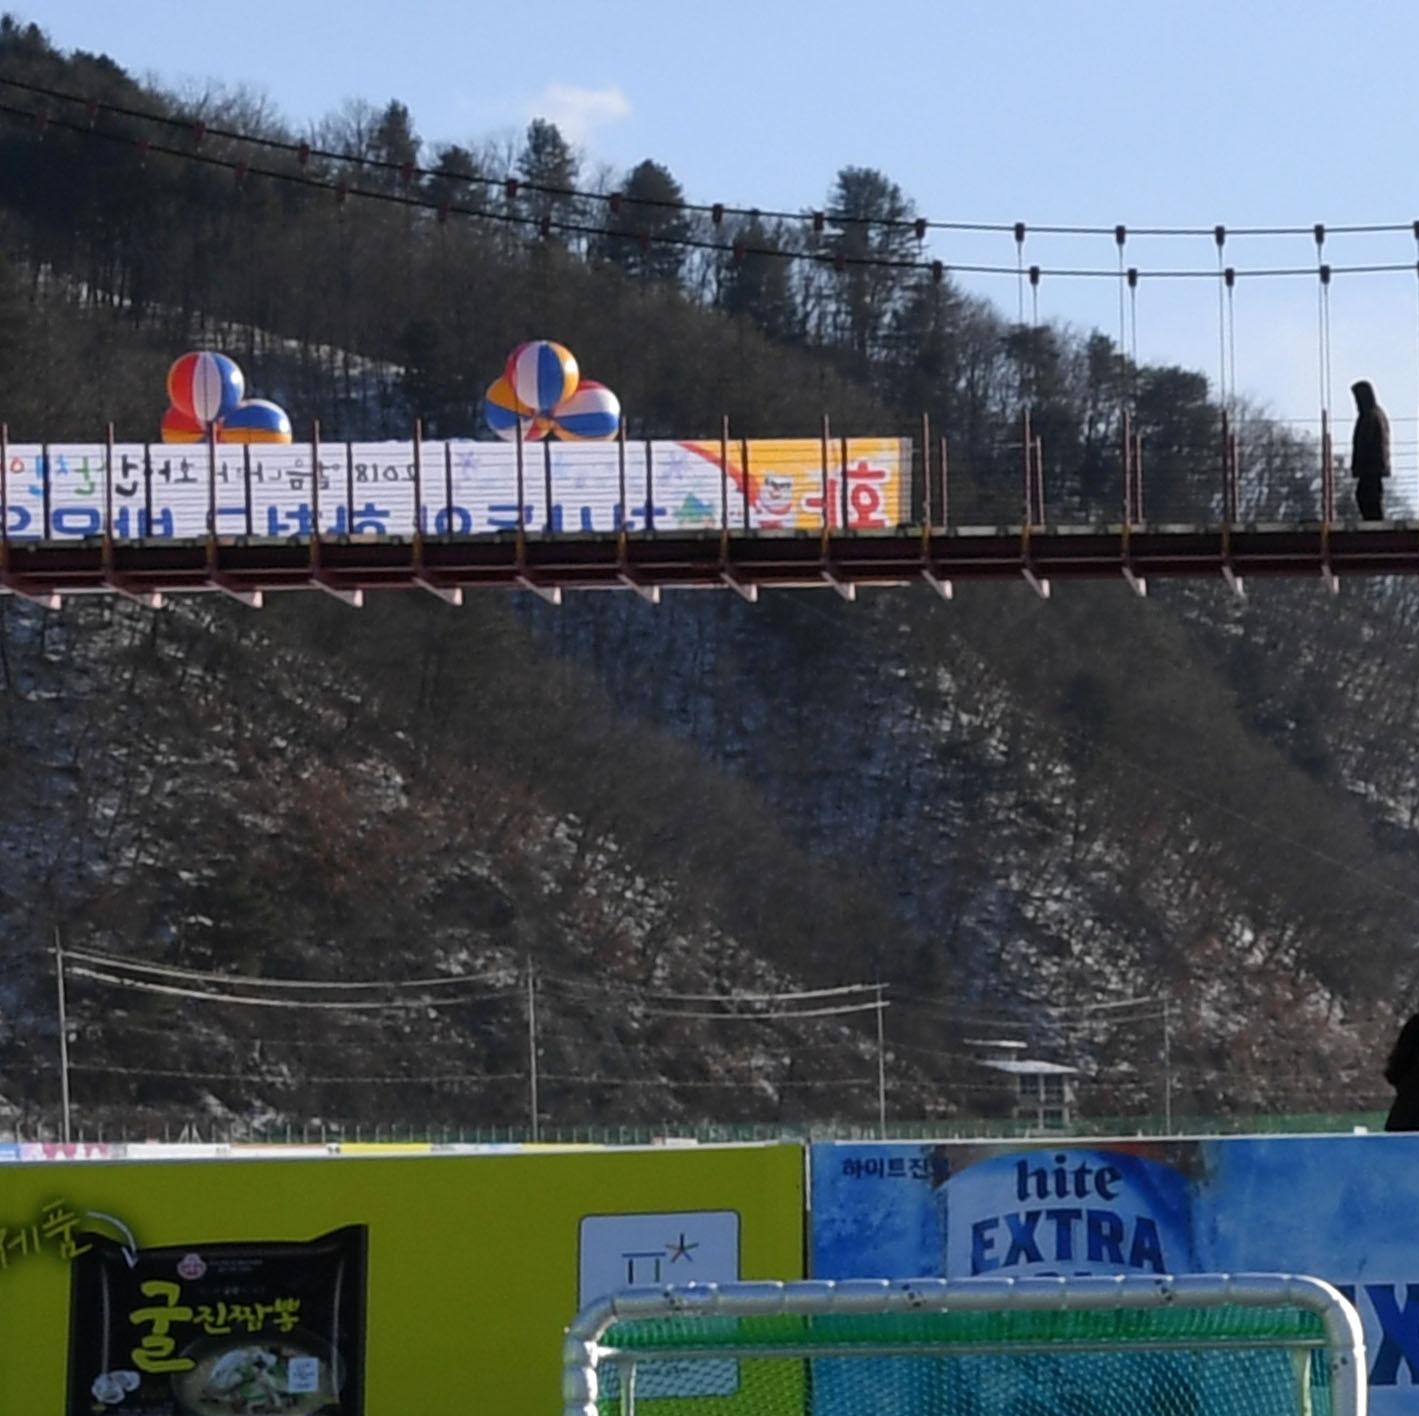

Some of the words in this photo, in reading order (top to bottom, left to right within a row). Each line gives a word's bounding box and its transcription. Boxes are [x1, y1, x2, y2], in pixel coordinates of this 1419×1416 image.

[1015, 1153, 1123, 1203] hite
[970, 1207, 1167, 1277] EXTRA
[129, 1280, 197, 1374] 굴
[192, 1298, 301, 1335] 진짬뽕
